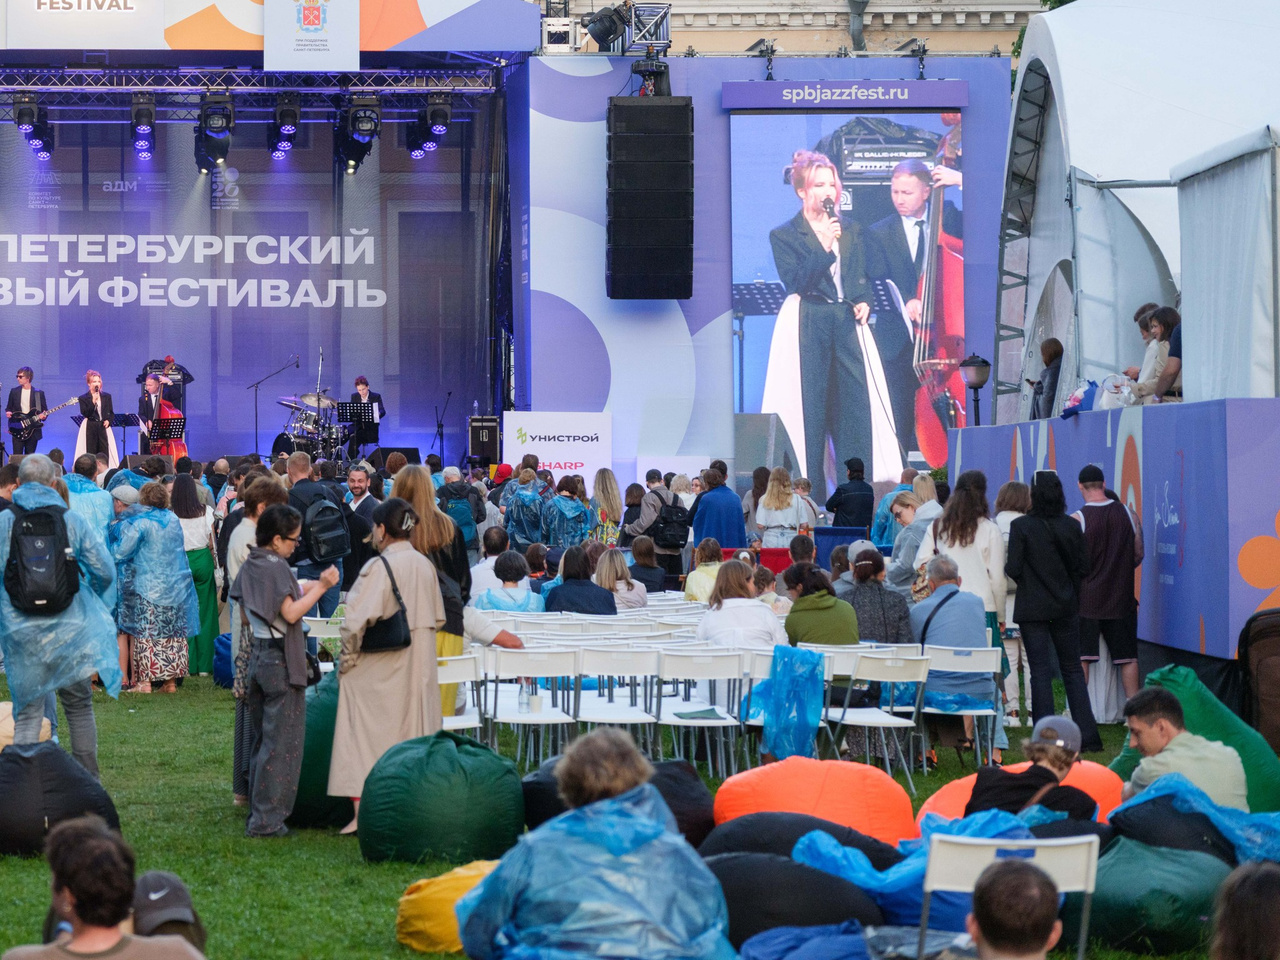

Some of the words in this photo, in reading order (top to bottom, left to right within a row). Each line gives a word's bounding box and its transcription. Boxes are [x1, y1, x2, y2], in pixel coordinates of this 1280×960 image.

[782, 85, 909, 104] spbjazzfest.ru
[98, 276, 387, 308] ФЕСТИВАЛЬ
[530, 433, 599, 442] УНИСТРОЙ
